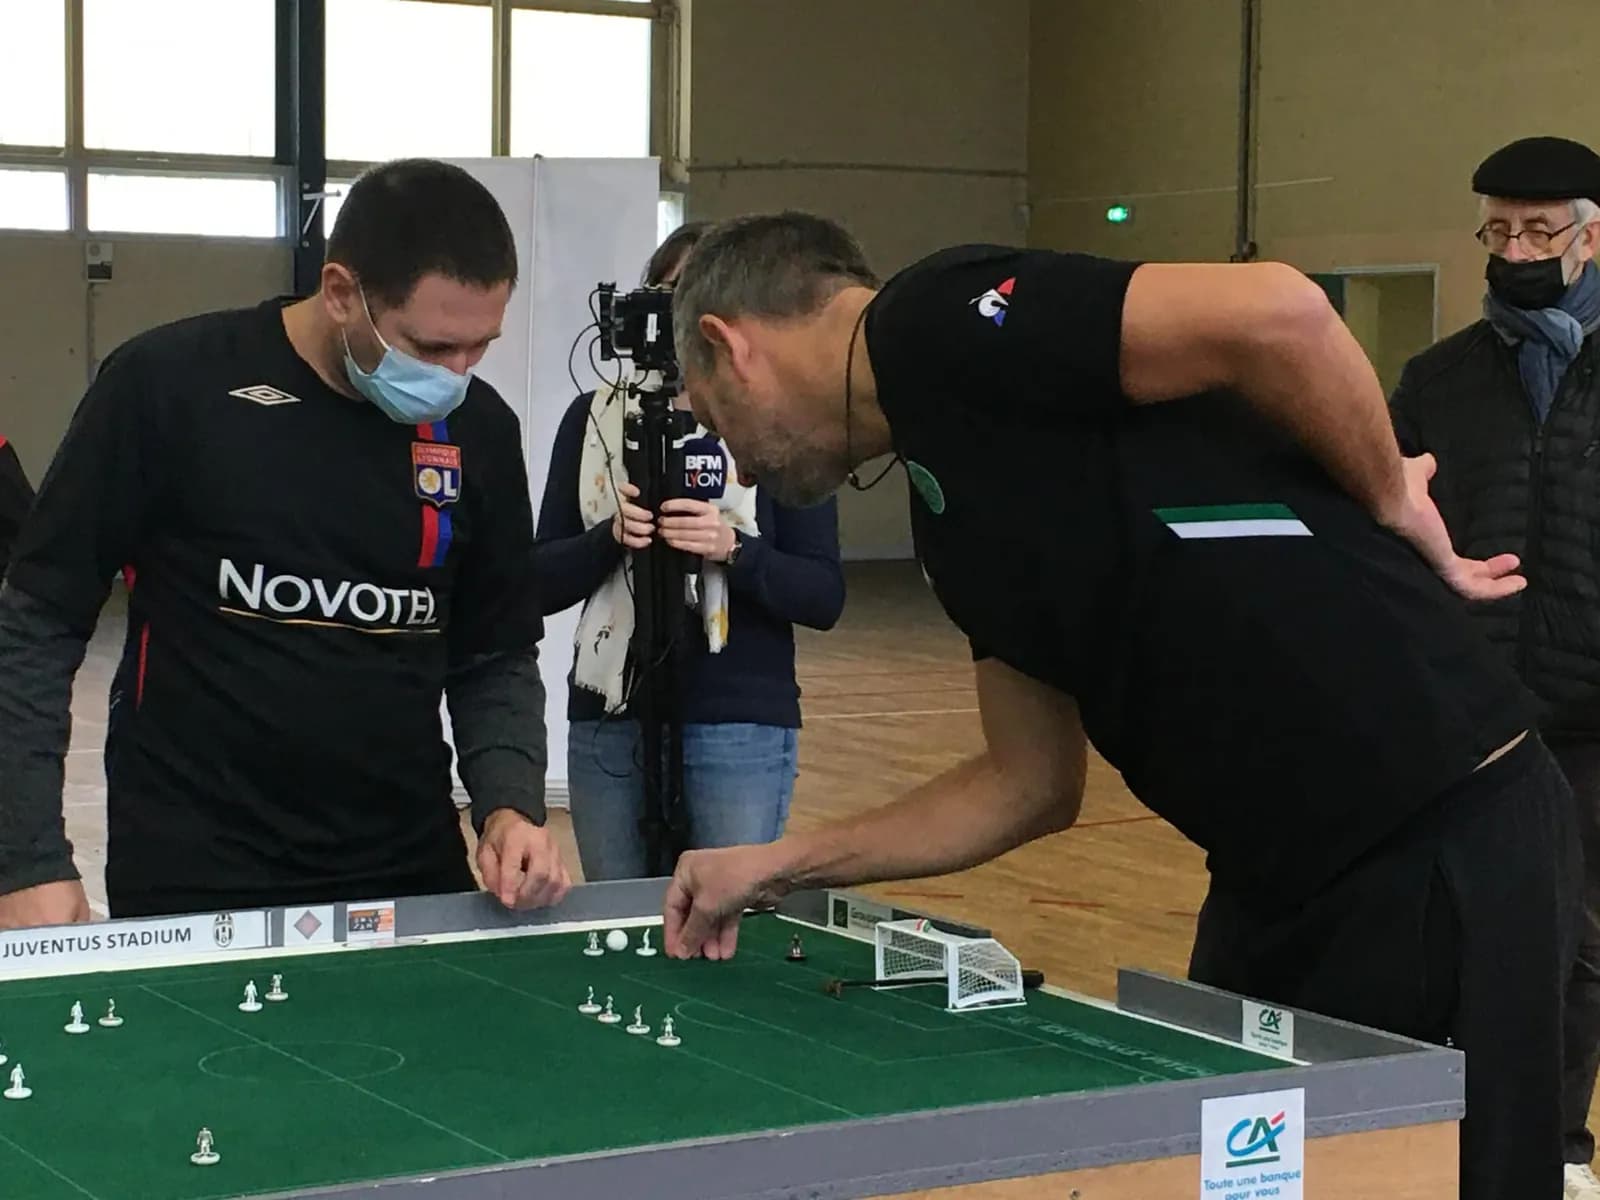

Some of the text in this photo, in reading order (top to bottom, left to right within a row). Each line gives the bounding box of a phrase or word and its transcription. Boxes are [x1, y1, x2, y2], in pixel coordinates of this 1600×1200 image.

[685, 455, 723, 470] BFM
[418, 468, 457, 497] OL
[685, 470, 723, 488] LYON
[218, 558, 438, 625] NOVOTEL
[3, 927, 192, 958] JUVENTUS STADIUM
[1204, 1169, 1302, 1191] Toute une banque
[1225, 1186, 1280, 1200] pour vous
